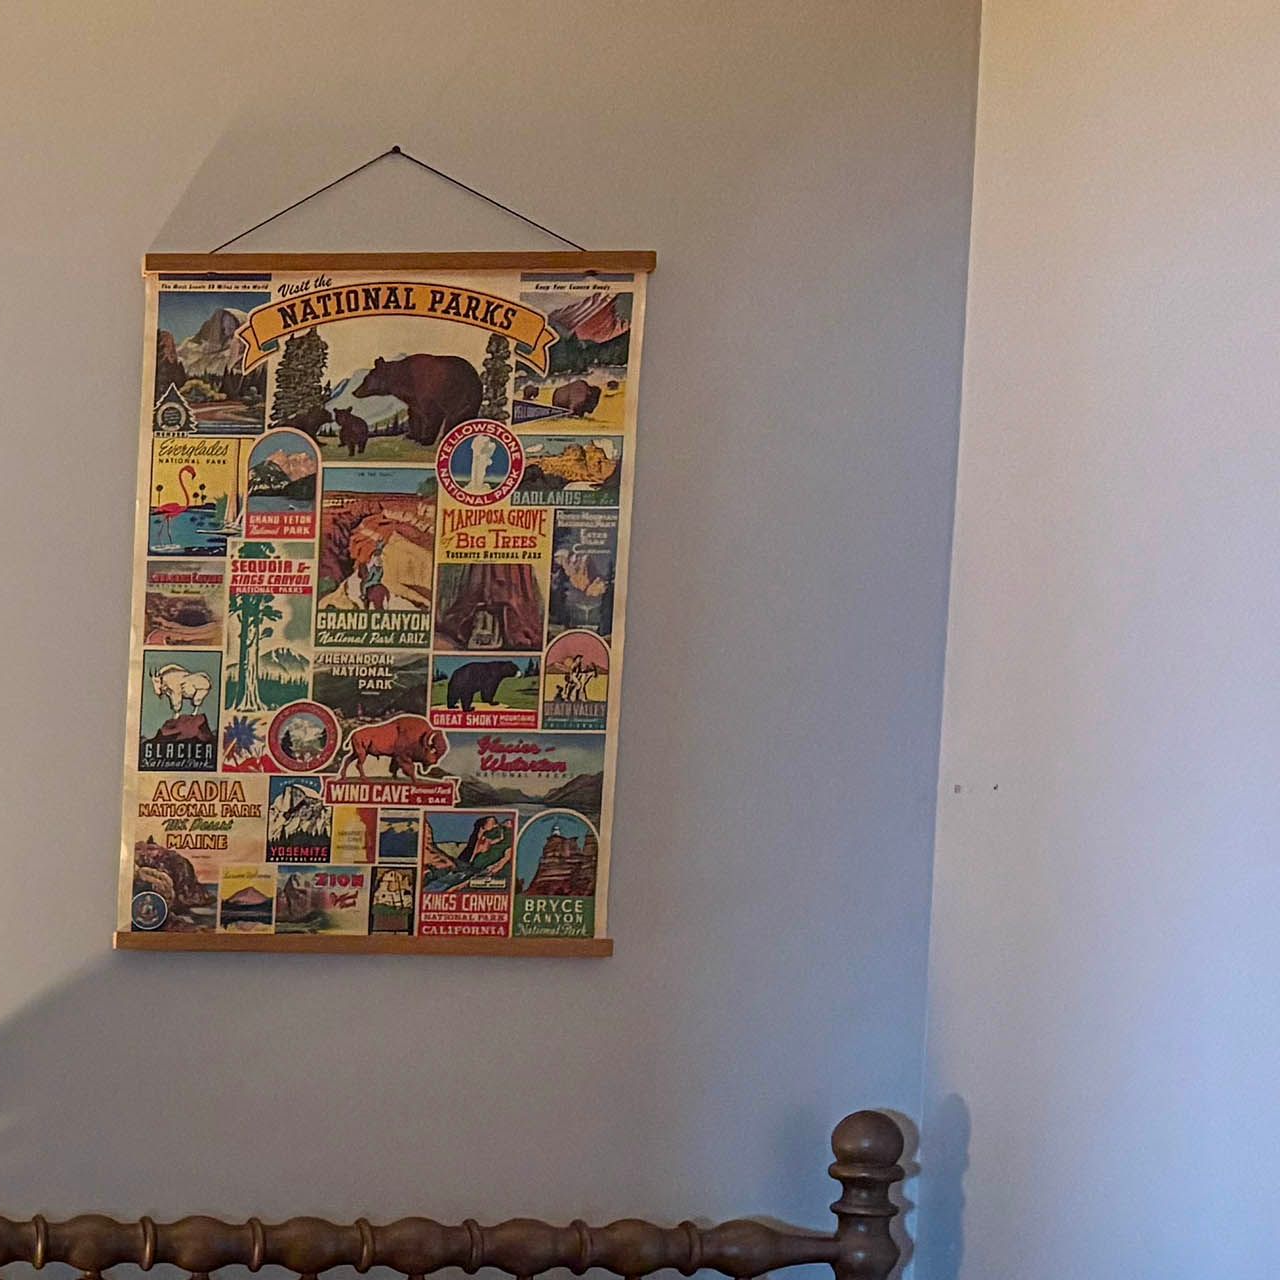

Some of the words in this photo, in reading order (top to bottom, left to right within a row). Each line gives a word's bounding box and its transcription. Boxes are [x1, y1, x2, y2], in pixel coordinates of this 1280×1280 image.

[277, 282, 313, 298] Visit
[313, 274, 334, 288] the
[277, 287, 416, 330] NATIONAL
[427, 289, 517, 331] PARKS
[158, 439, 230, 459] Everglades
[440, 423, 522, 462] YELLOWSTONE
[440, 467, 492, 505] NATIONAL
[494, 469, 521, 500] PARK
[512, 490, 582, 505] BADLANDS
[249, 515, 280, 524] GRAND
[442, 508, 506, 537] MARIPOSA
[507, 509, 548, 537] GROVE
[283, 525, 311, 535] PARK
[455, 532, 487, 549] BIG
[488, 529, 538, 549] TREES
[445, 551, 480, 559] YOSEMITE
[483, 551, 519, 559] NATIONAL
[521, 551, 542, 559] PARK
[231, 560, 293, 573] SEQUOIA
[230, 574, 264, 585] KINGS
[267, 575, 311, 585] CANYON
[317, 612, 369, 630] GRAND
[371, 613, 430, 631] CANYON
[318, 631, 368, 644] National
[369, 632, 395, 644] Park
[398, 633, 429, 644] ARIZ.
[315, 653, 395, 665] SHENANDOAH
[332, 666, 393, 677] NATIONAL
[358, 679, 393, 690] PARK
[572, 702, 608, 716] VALLEY
[433, 713, 463, 725] GREAT
[466, 713, 499, 727] SMOKY
[144, 743, 213, 759] GLACIER
[141, 758, 185, 768] National
[152, 780, 246, 802] ACADIA
[330, 784, 371, 803] WIND
[372, 785, 409, 803] CAVE
[138, 803, 218, 818] NATIONAL
[221, 804, 262, 818] PARK
[166, 833, 229, 850] MAINE
[270, 846, 328, 857] YOSEMITE
[314, 872, 365, 887] ZION
[422, 894, 457, 911] KINGS
[461, 894, 509, 912] CANYON
[524, 899, 584, 913] BRYCE
[423, 913, 476, 921] NATIONAL
[478, 913, 505, 921] PARK
[522, 912, 584, 924] CANYON
[422, 925, 505, 935] CALIFORNIA
[515, 923, 560, 936] National
[561, 924, 590, 936] Park
